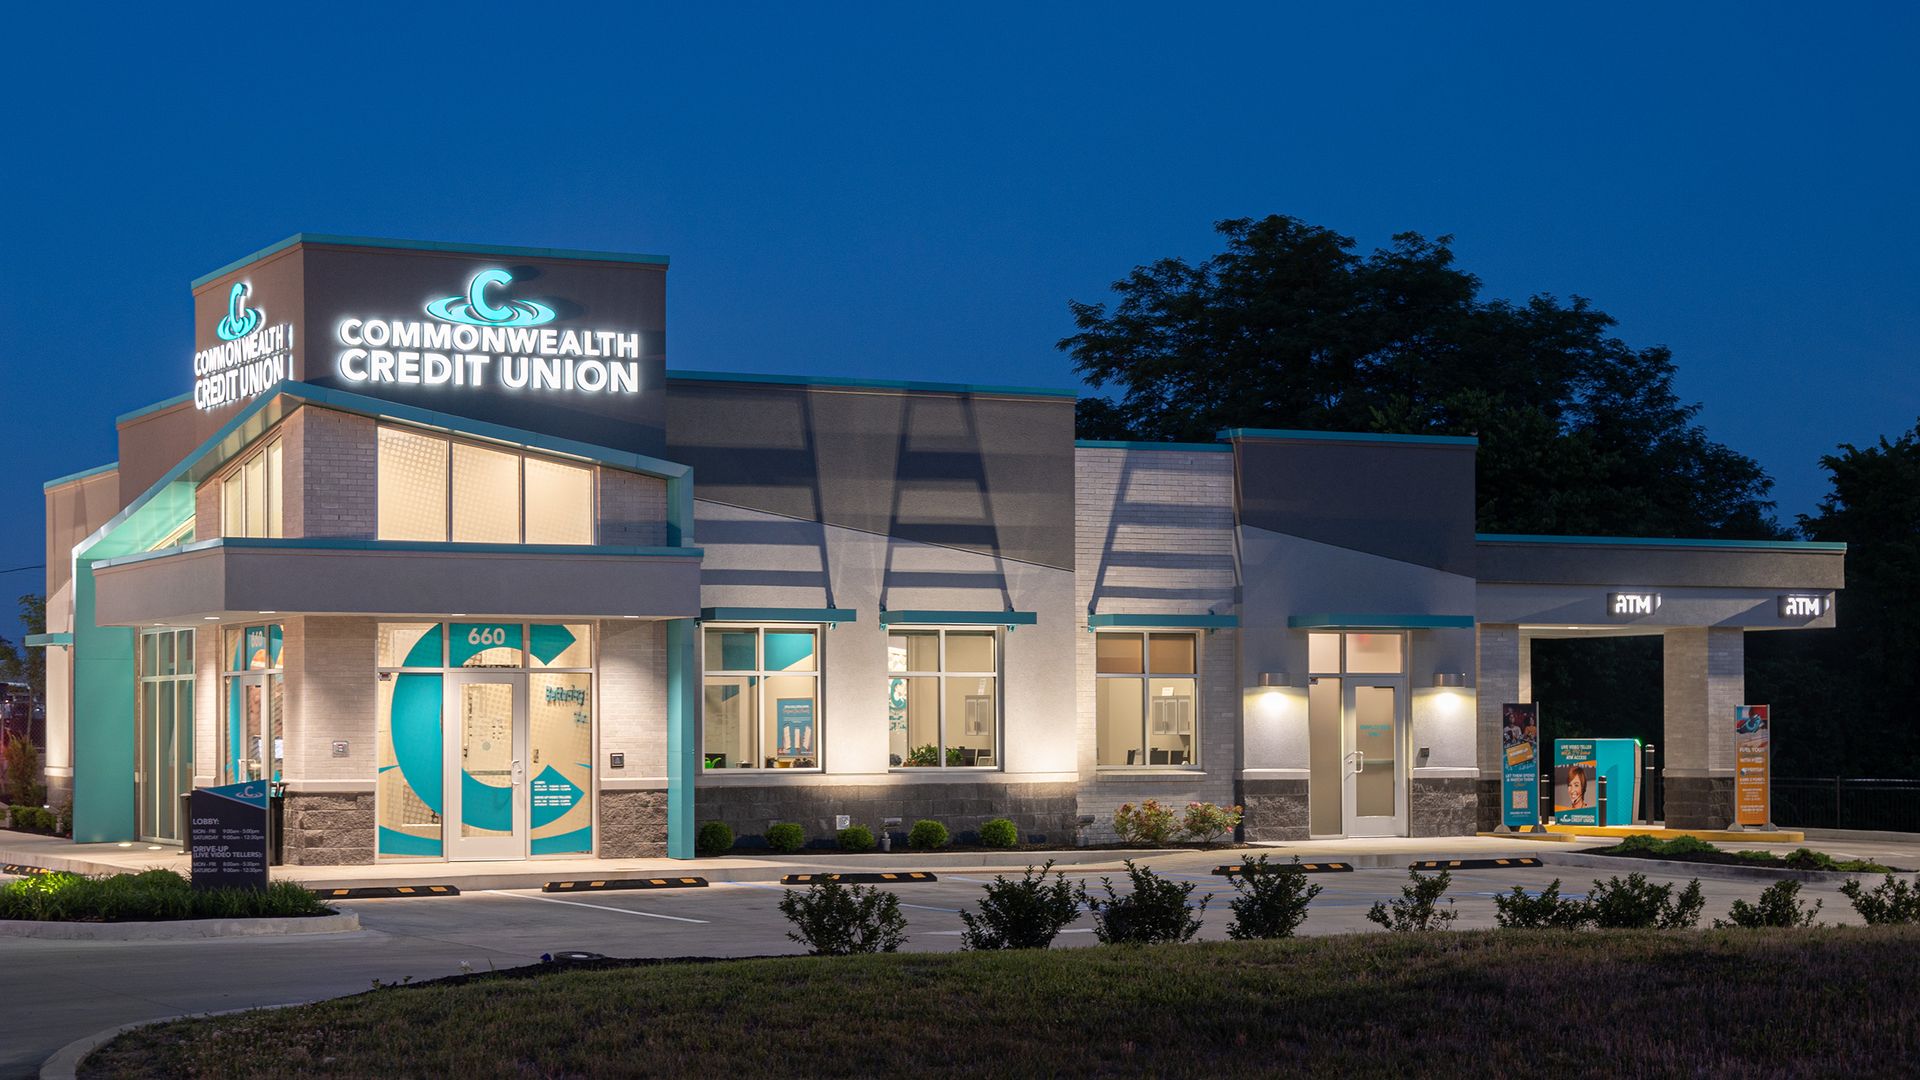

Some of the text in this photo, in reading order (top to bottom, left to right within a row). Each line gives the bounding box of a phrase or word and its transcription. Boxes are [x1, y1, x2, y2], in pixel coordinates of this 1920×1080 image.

[194, 324, 284, 376] COMMONWEALTH
[340, 318, 639, 358] COMMONWEALTH
[194, 354, 284, 410] CREDIT UNION
[340, 348, 639, 393] CREDIT UNION
[1615, 595, 1651, 614] ATM
[1786, 597, 1820, 616] ATM
[468, 627, 506, 645] 660
